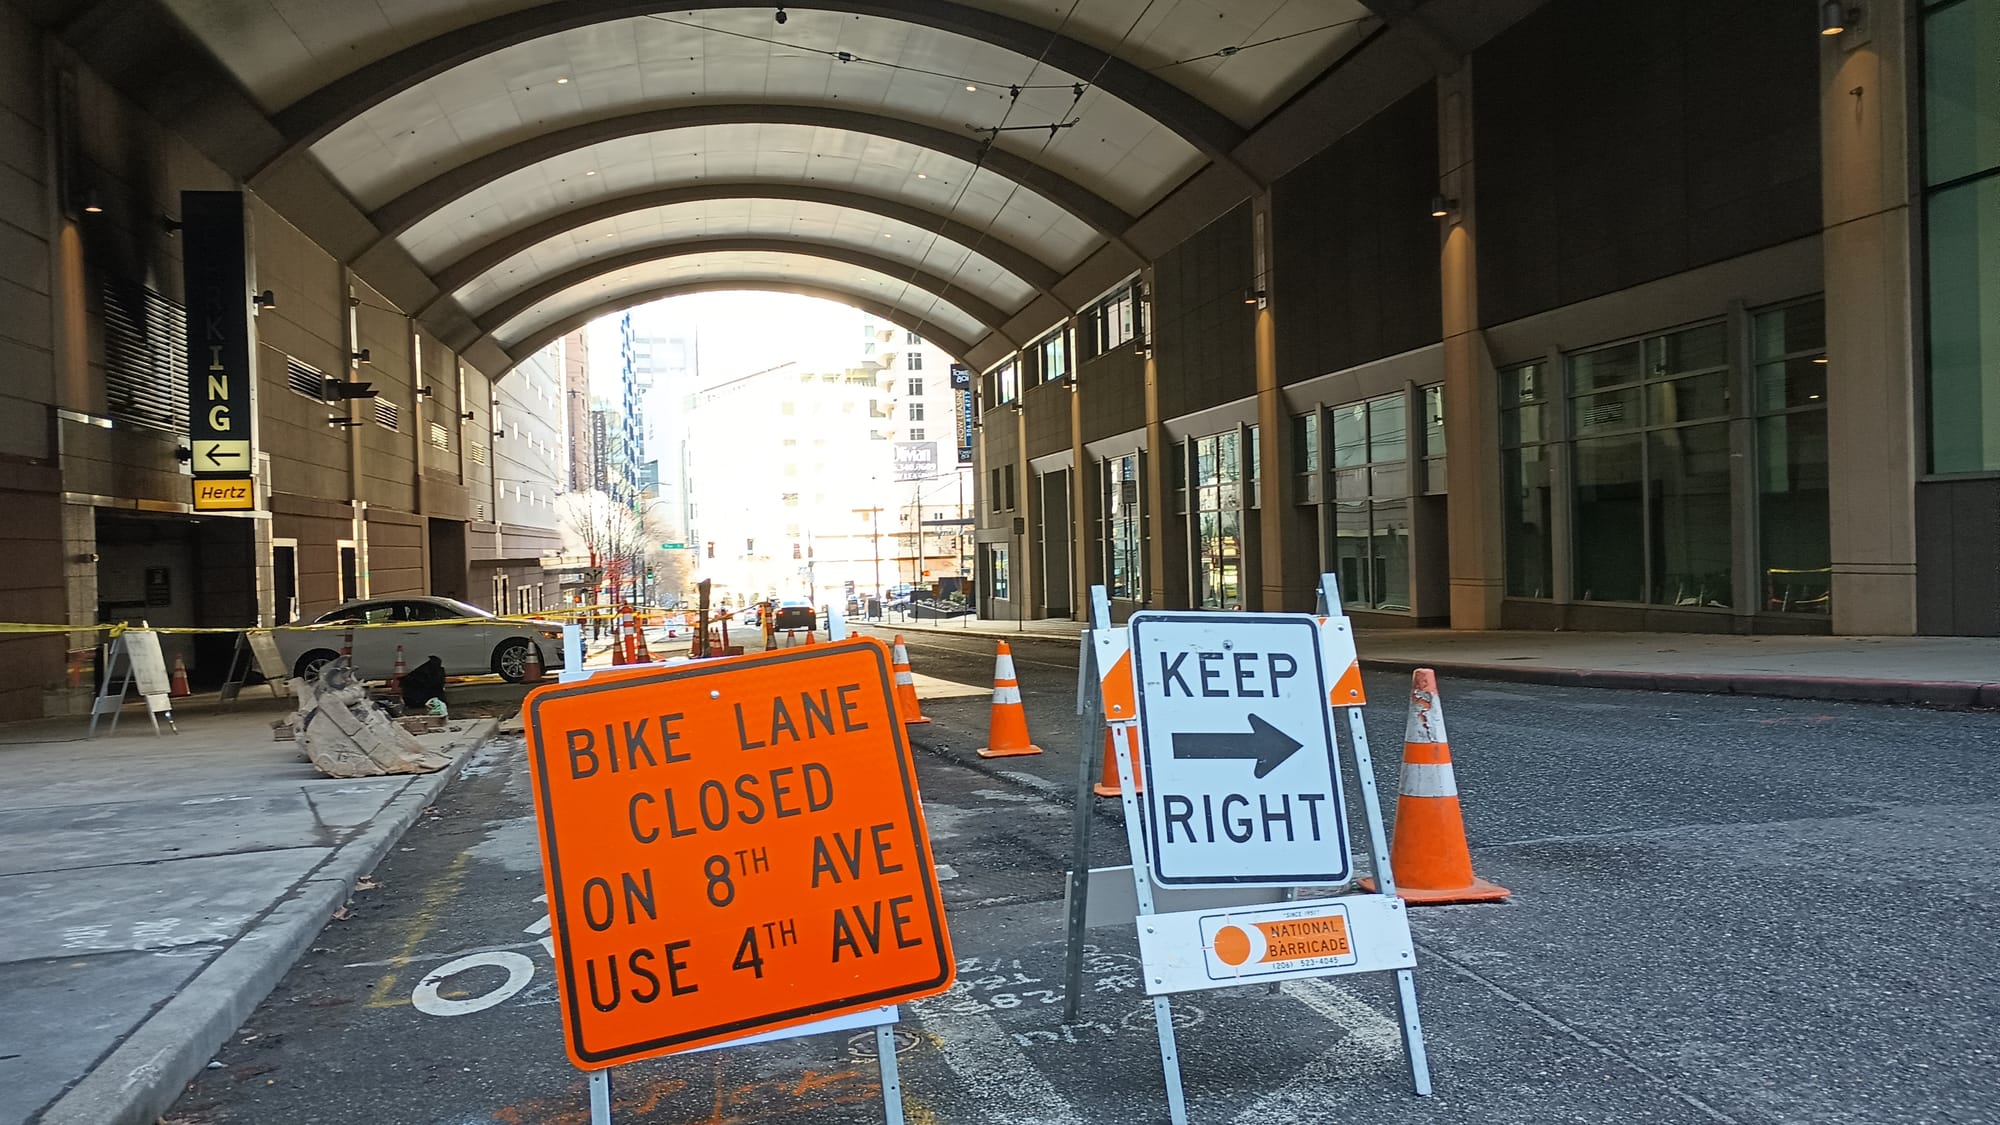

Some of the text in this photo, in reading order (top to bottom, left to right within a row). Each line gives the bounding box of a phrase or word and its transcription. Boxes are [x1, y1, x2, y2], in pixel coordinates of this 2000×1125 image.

[201, 486, 247, 499] Hertz
[1160, 651, 1298, 698] KEEP
[566, 683, 868, 779] BIKE LANE
[628, 763, 833, 844] CLOSED
[1163, 794, 1325, 843] RIGHT
[582, 822, 903, 932] ON 8TH AVE
[1269, 938, 1347, 957] BARRICADE
[1270, 920, 1339, 938] NATIONAL
[586, 895, 922, 1013] USE 4TH AVE
[1272, 961, 1293, 970] (206)
